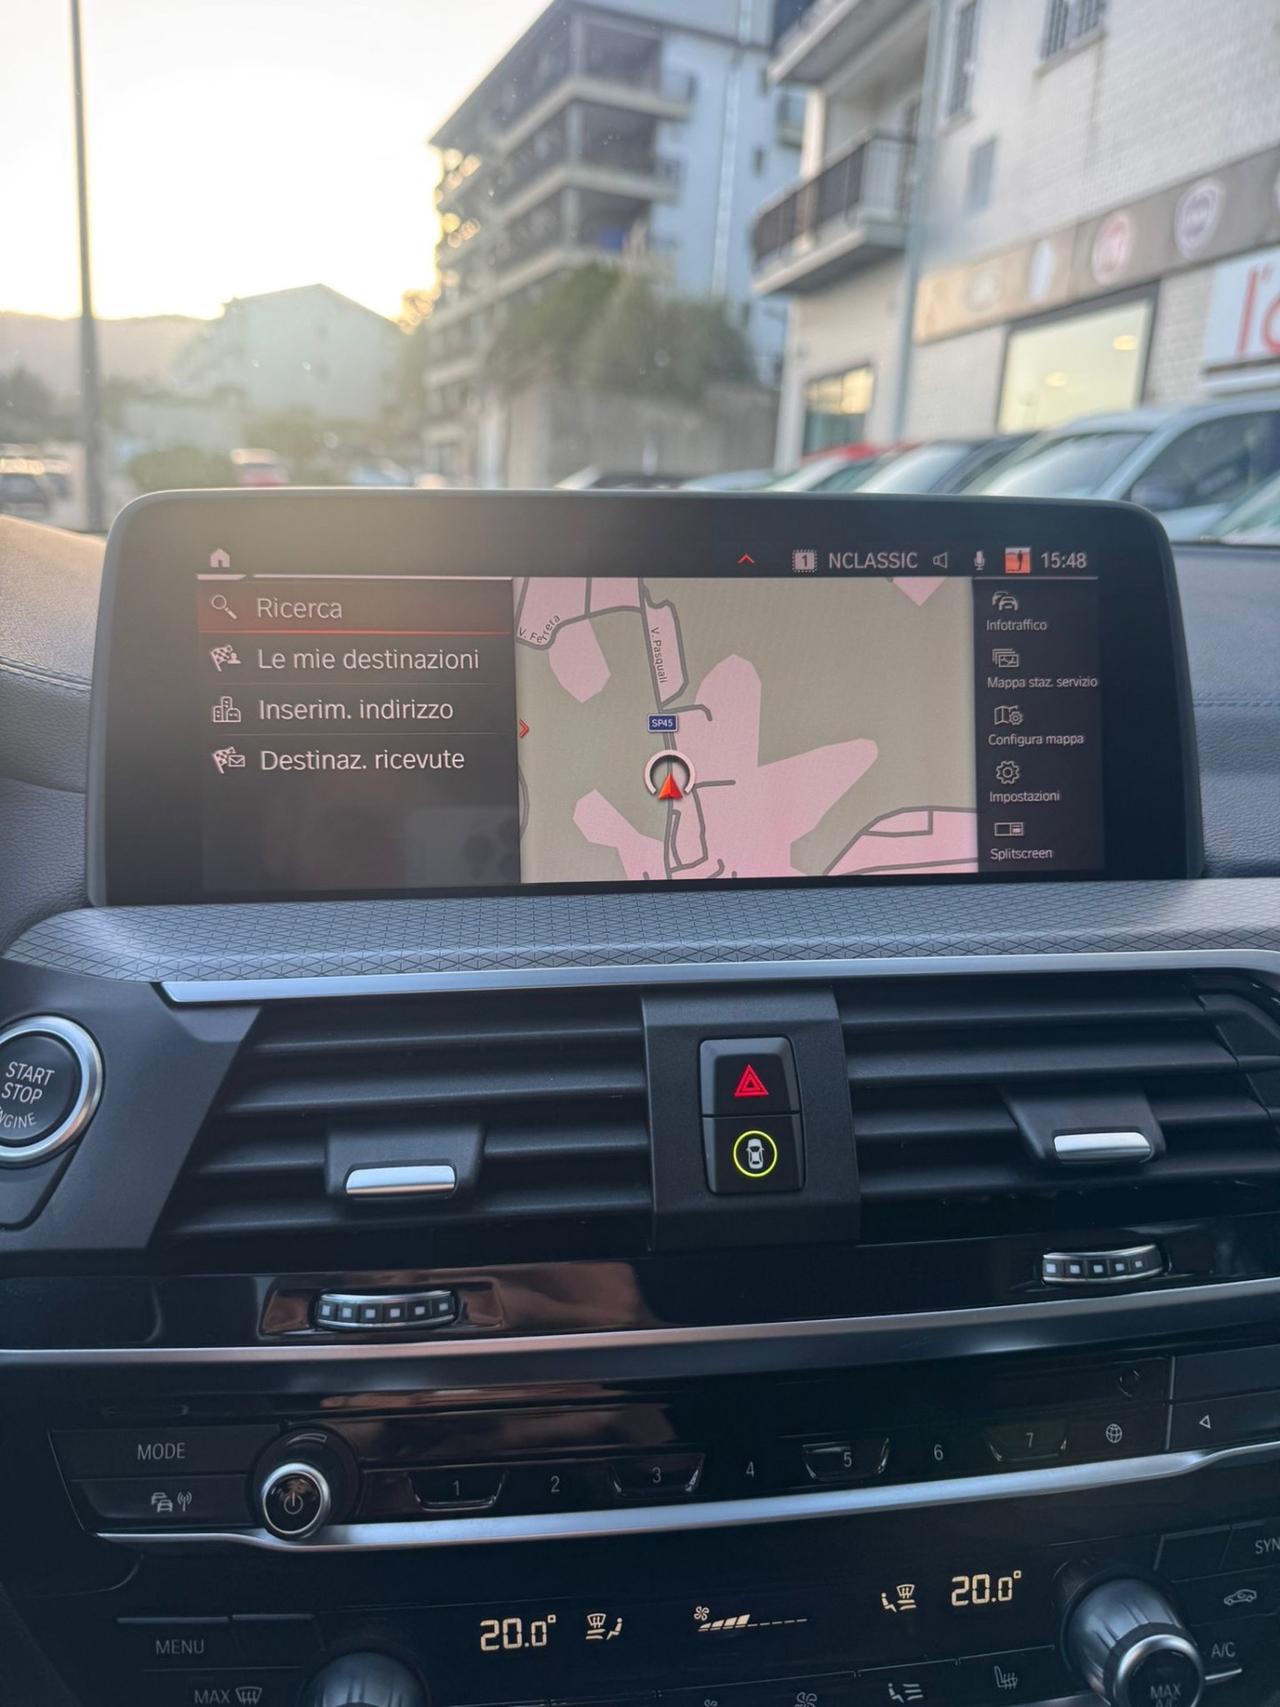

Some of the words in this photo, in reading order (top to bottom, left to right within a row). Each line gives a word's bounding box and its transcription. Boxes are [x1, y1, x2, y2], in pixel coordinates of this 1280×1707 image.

[828, 551, 919, 570] NCLASSIC
[1041, 551, 1087, 569] 15:48
[256, 597, 343, 619] Ricerca
[986, 618, 1048, 632] Infotraffico
[257, 651, 286, 670] Le
[293, 649, 338, 669] mie
[343, 648, 480, 670] destinazioni
[653, 640, 668, 683] Pasquali
[987, 676, 1026, 690] Mappa
[1029, 676, 1053, 688] staz.
[1056, 674, 1098, 688] servizio
[259, 700, 351, 721] Inserim.
[360, 699, 454, 720] indirizzo
[651, 718, 673, 728] SP45
[988, 733, 1043, 748] Configura
[1046, 735, 1084, 746] mappa
[260, 750, 367, 771] Destinaz.
[375, 747, 465, 770] ricevute
[989, 789, 1060, 804] Impostazioni
[990, 848, 1053, 861] Splitscreen
[5, 1061, 55, 1086] START
[1, 1082, 43, 1105] STOP
[0, 1106, 37, 1129] NGINE
[1025, 1432, 1035, 1448] 7
[137, 1442, 186, 1461] MODE
[934, 1444, 944, 1461] 6
[842, 1452, 852, 1468] 5
[652, 1467, 662, 1484] 3
[745, 1461, 755, 1477] 4
[453, 1480, 461, 1496] 1
[551, 1476, 560, 1493] 2
[155, 1640, 205, 1655] MENU
[1211, 1642, 1236, 1658] A/C
[194, 1690, 231, 1704] MAX
[1150, 1683, 1182, 1699] MAX
